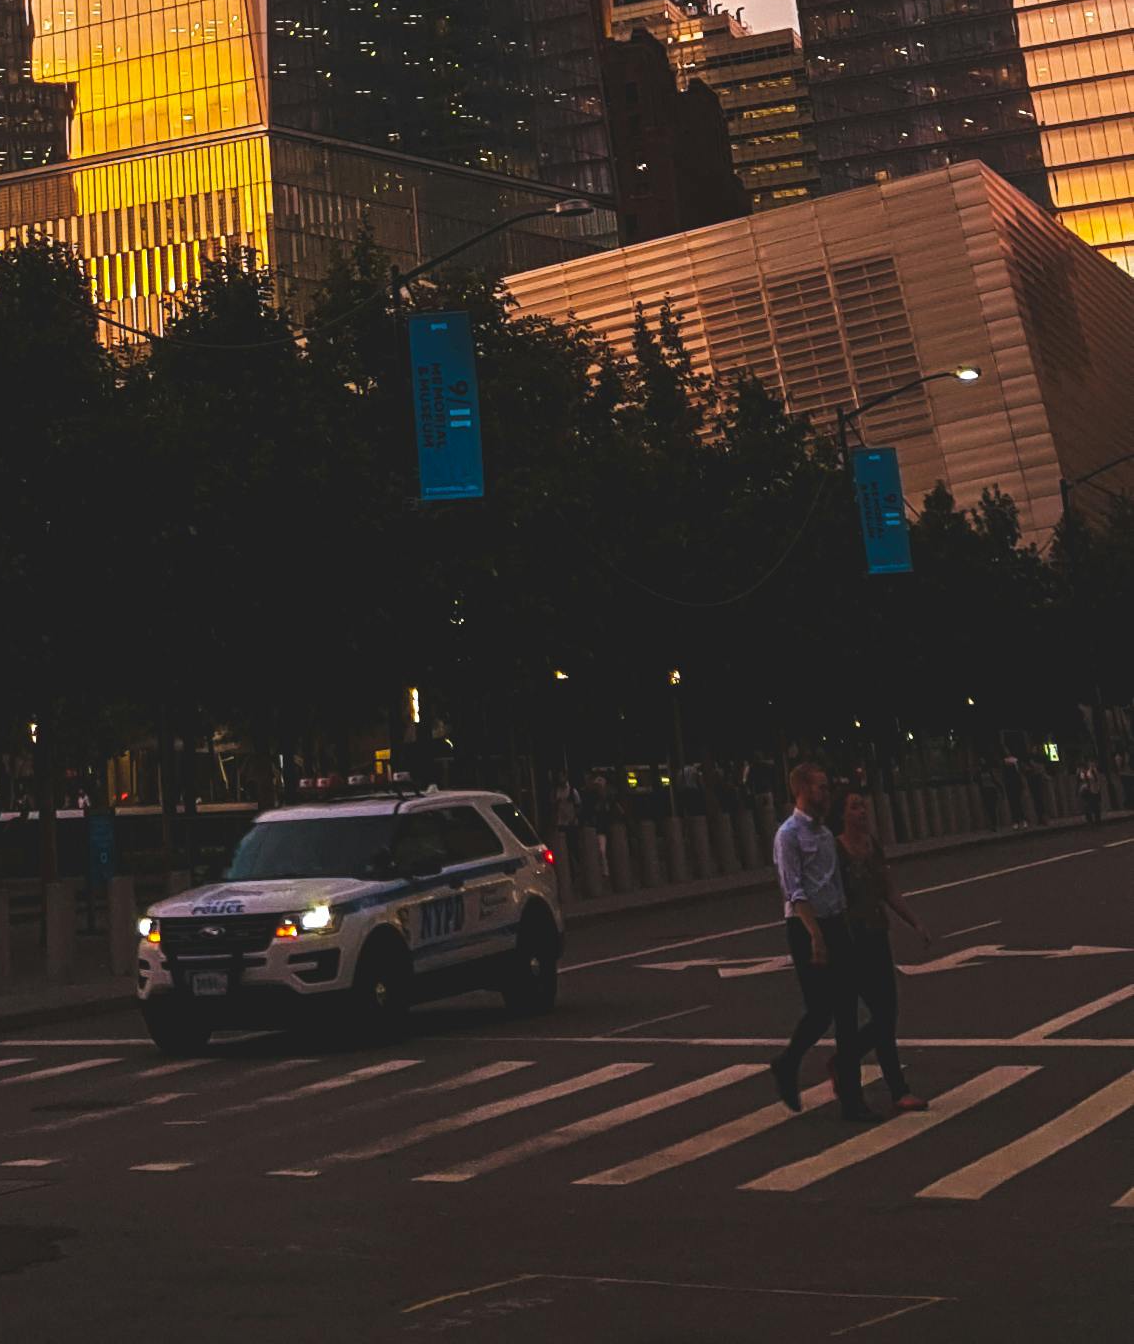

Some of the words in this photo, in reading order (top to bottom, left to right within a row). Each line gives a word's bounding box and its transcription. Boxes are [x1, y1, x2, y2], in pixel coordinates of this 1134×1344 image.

[419, 378, 435, 448] MUSEUM
[429, 362, 447, 449] MEMORIAL
[448, 380, 473, 428] 9/11
[192, 903, 246, 915] POLICE
[419, 894, 465, 940] NYPD
